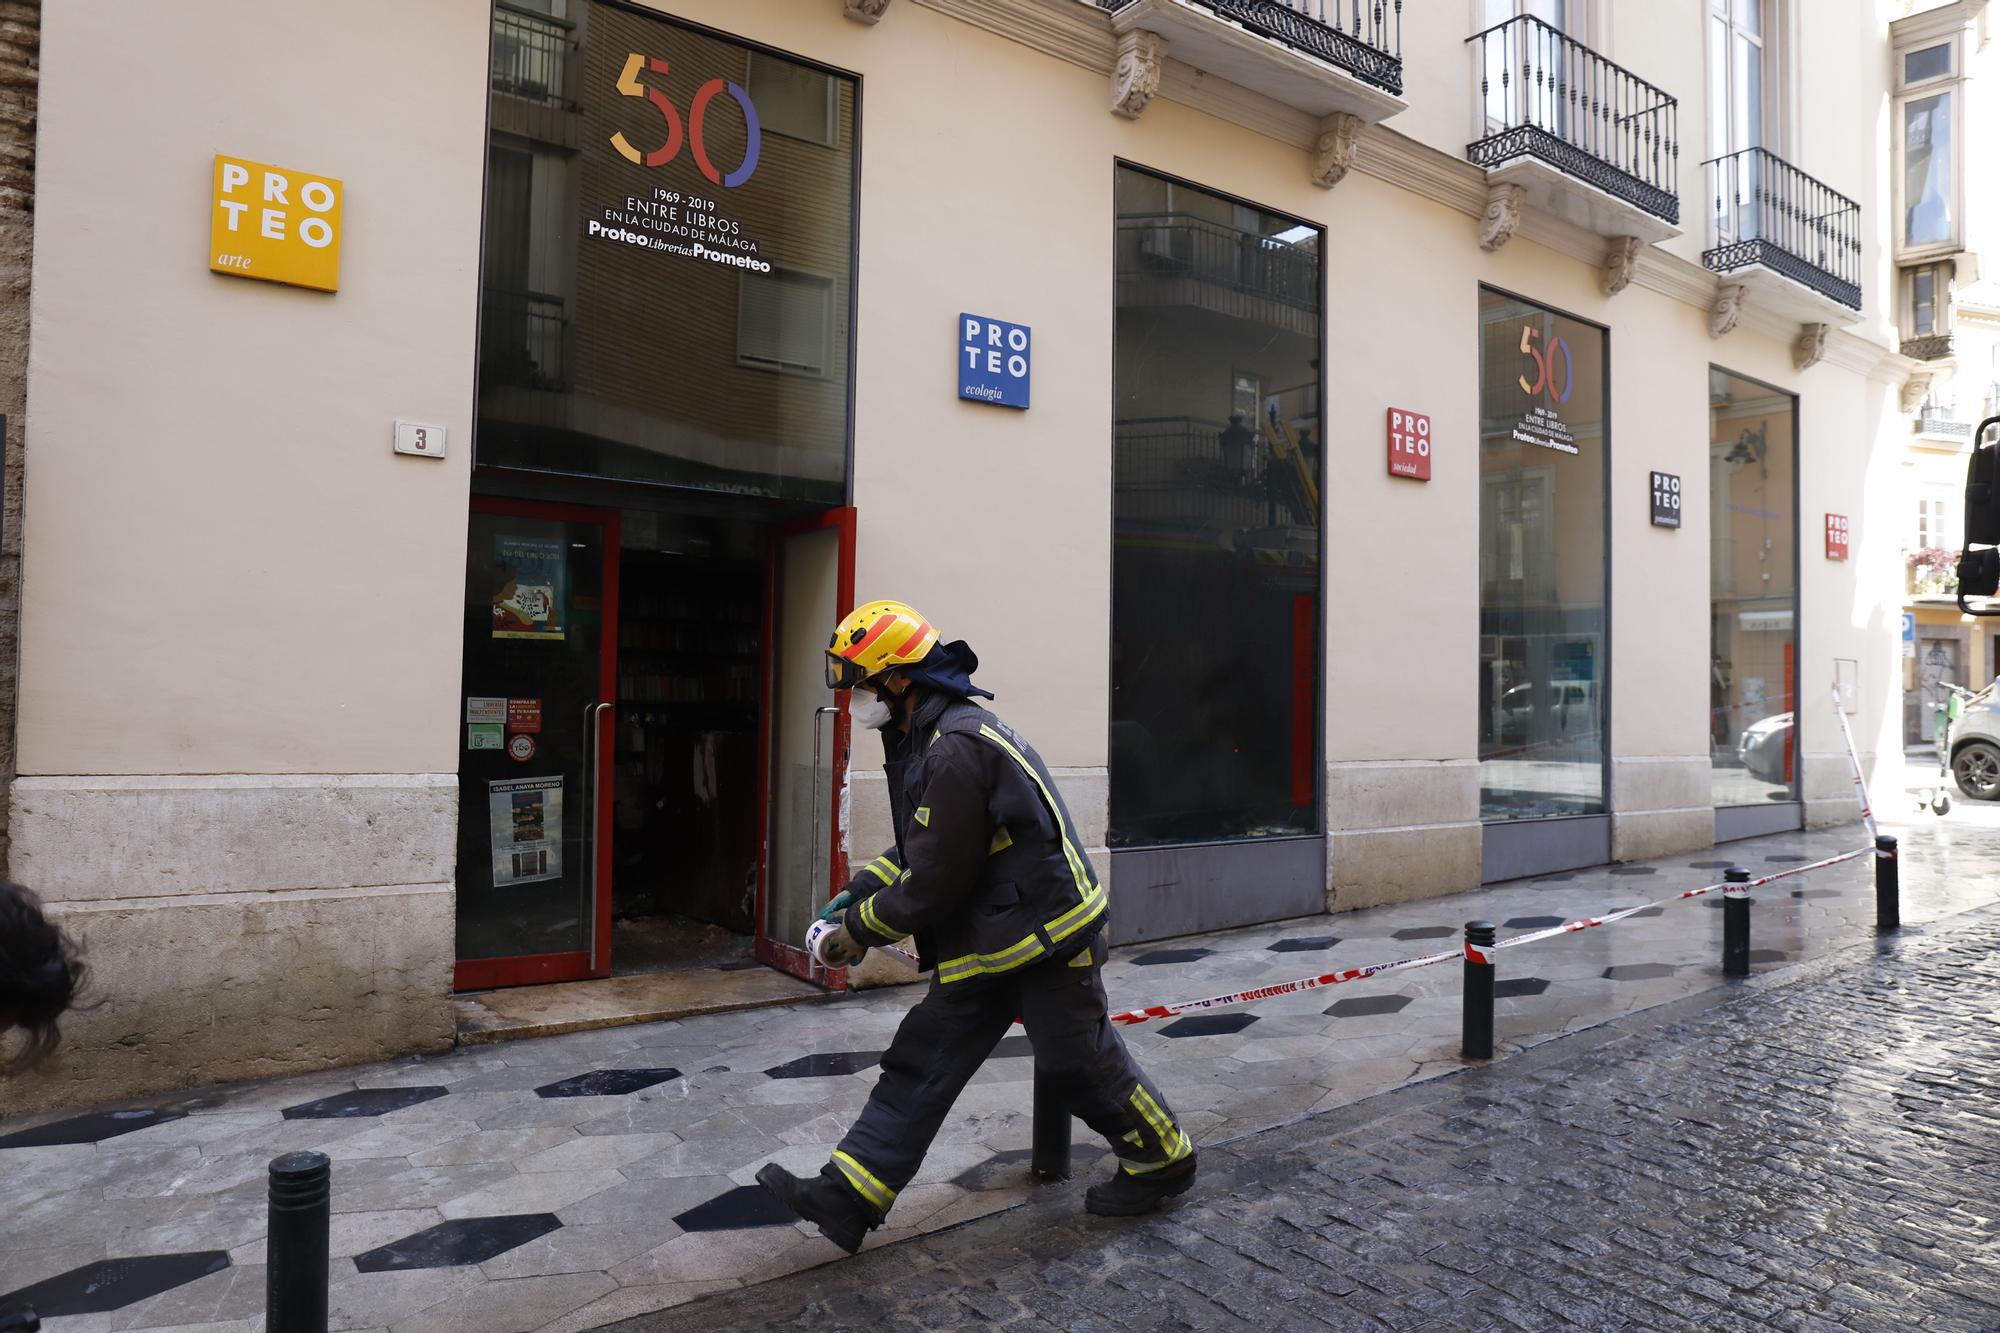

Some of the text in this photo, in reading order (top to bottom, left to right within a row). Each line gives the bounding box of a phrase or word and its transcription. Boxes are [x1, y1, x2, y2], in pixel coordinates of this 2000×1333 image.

[609, 53, 761, 188] 50
[222, 163, 335, 212] PRO
[219, 199, 333, 248] TEO
[627, 197, 739, 235] ENTRE LIBROS
[605, 209, 757, 253] EN LA CIUDAD DE MÁLAGA
[218, 252, 252, 269] arte
[966, 319, 1027, 352] PRO
[965, 345, 1027, 378] TEO
[1519, 325, 1573, 406] 50
[1392, 412, 1429, 436] PRO
[1525, 413, 1567, 433] ENTRE LIBROS
[415, 428, 427, 450] 3
[1392, 433, 1429, 457] TEO
[1654, 474, 1680, 493] PRO
[1654, 491, 1680, 510] TEO
[1828, 515, 1848, 531] PRO
[1828, 530, 1848, 545] TEO
[535, 781, 561, 790] MORENO
